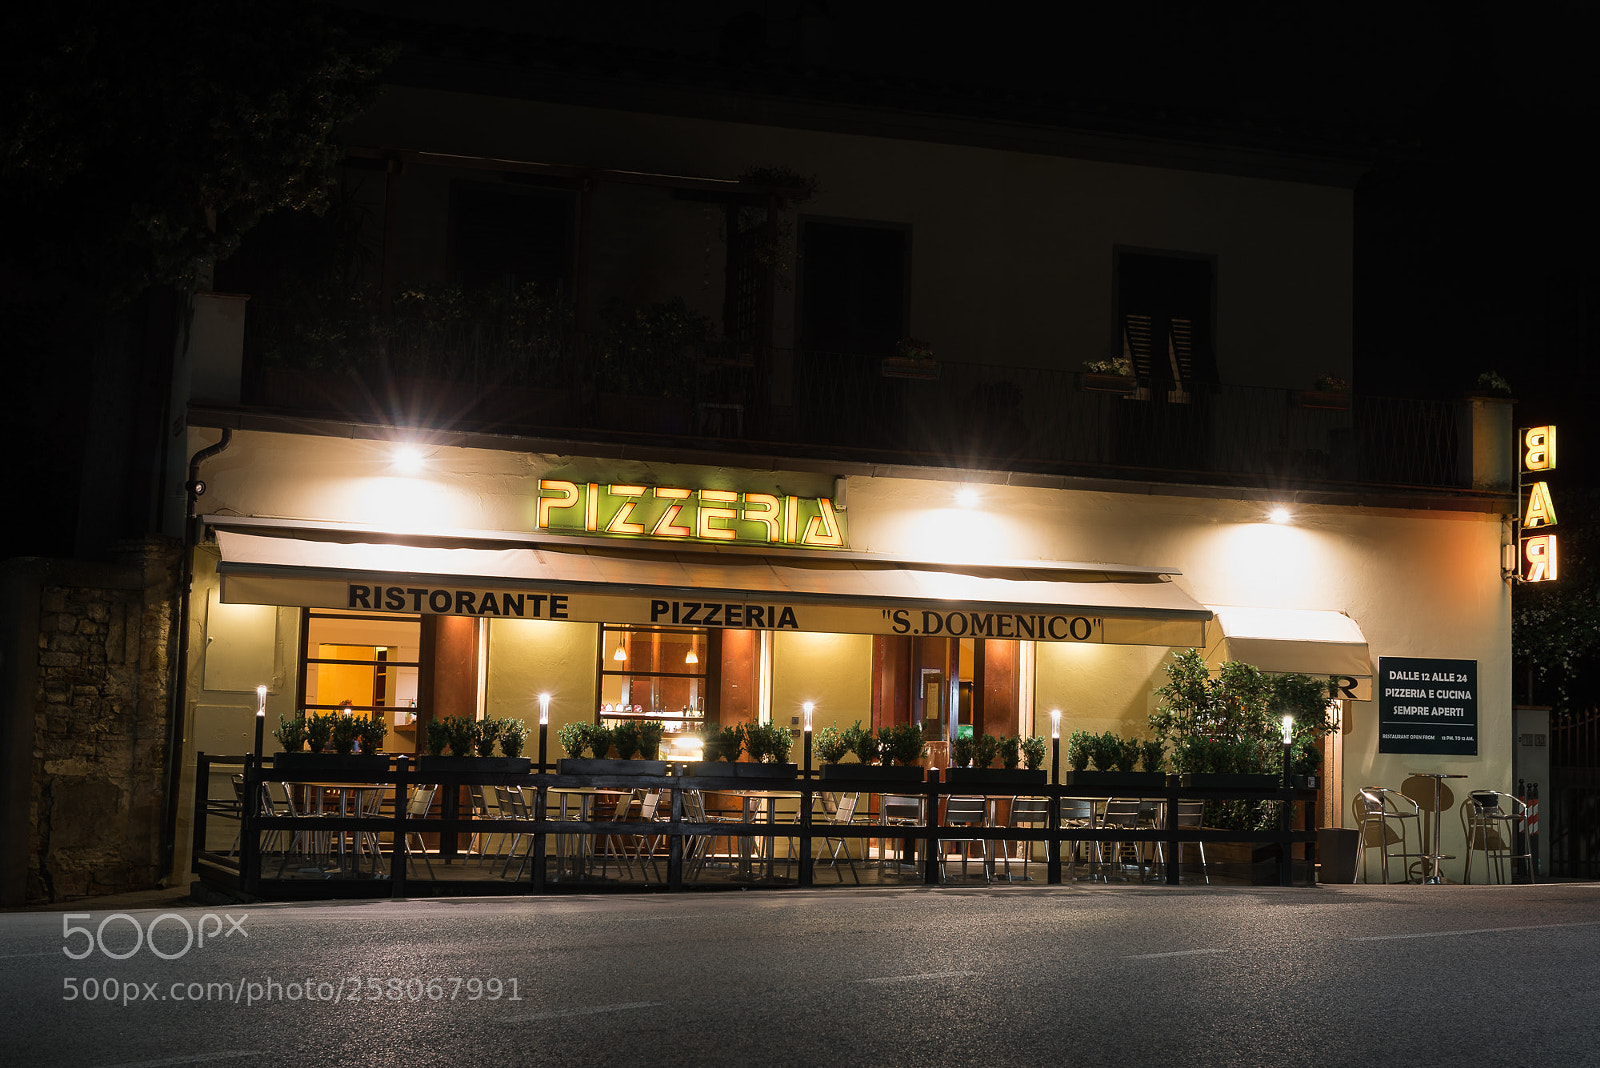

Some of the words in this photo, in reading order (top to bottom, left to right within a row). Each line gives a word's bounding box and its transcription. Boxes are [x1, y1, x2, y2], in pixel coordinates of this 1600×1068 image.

[536, 479, 844, 547] PIZZERIA
[349, 584, 569, 619] RISTORANTE
[650, 599, 799, 629] PIZZERIA
[882, 609, 1101, 641] "S.DOMENICO"
[1389, 670, 1420, 681] DALLE
[1421, 672, 1430, 681] 12
[1431, 672, 1455, 682] ALLE
[1456, 673, 1468, 683] 24
[1385, 688, 1427, 699] PIZZERIA
[1428, 689, 1435, 699] E
[1436, 689, 1472, 700] CUCINA
[1393, 705, 1430, 716] SEMPRE
[1431, 706, 1464, 717] APERTI
